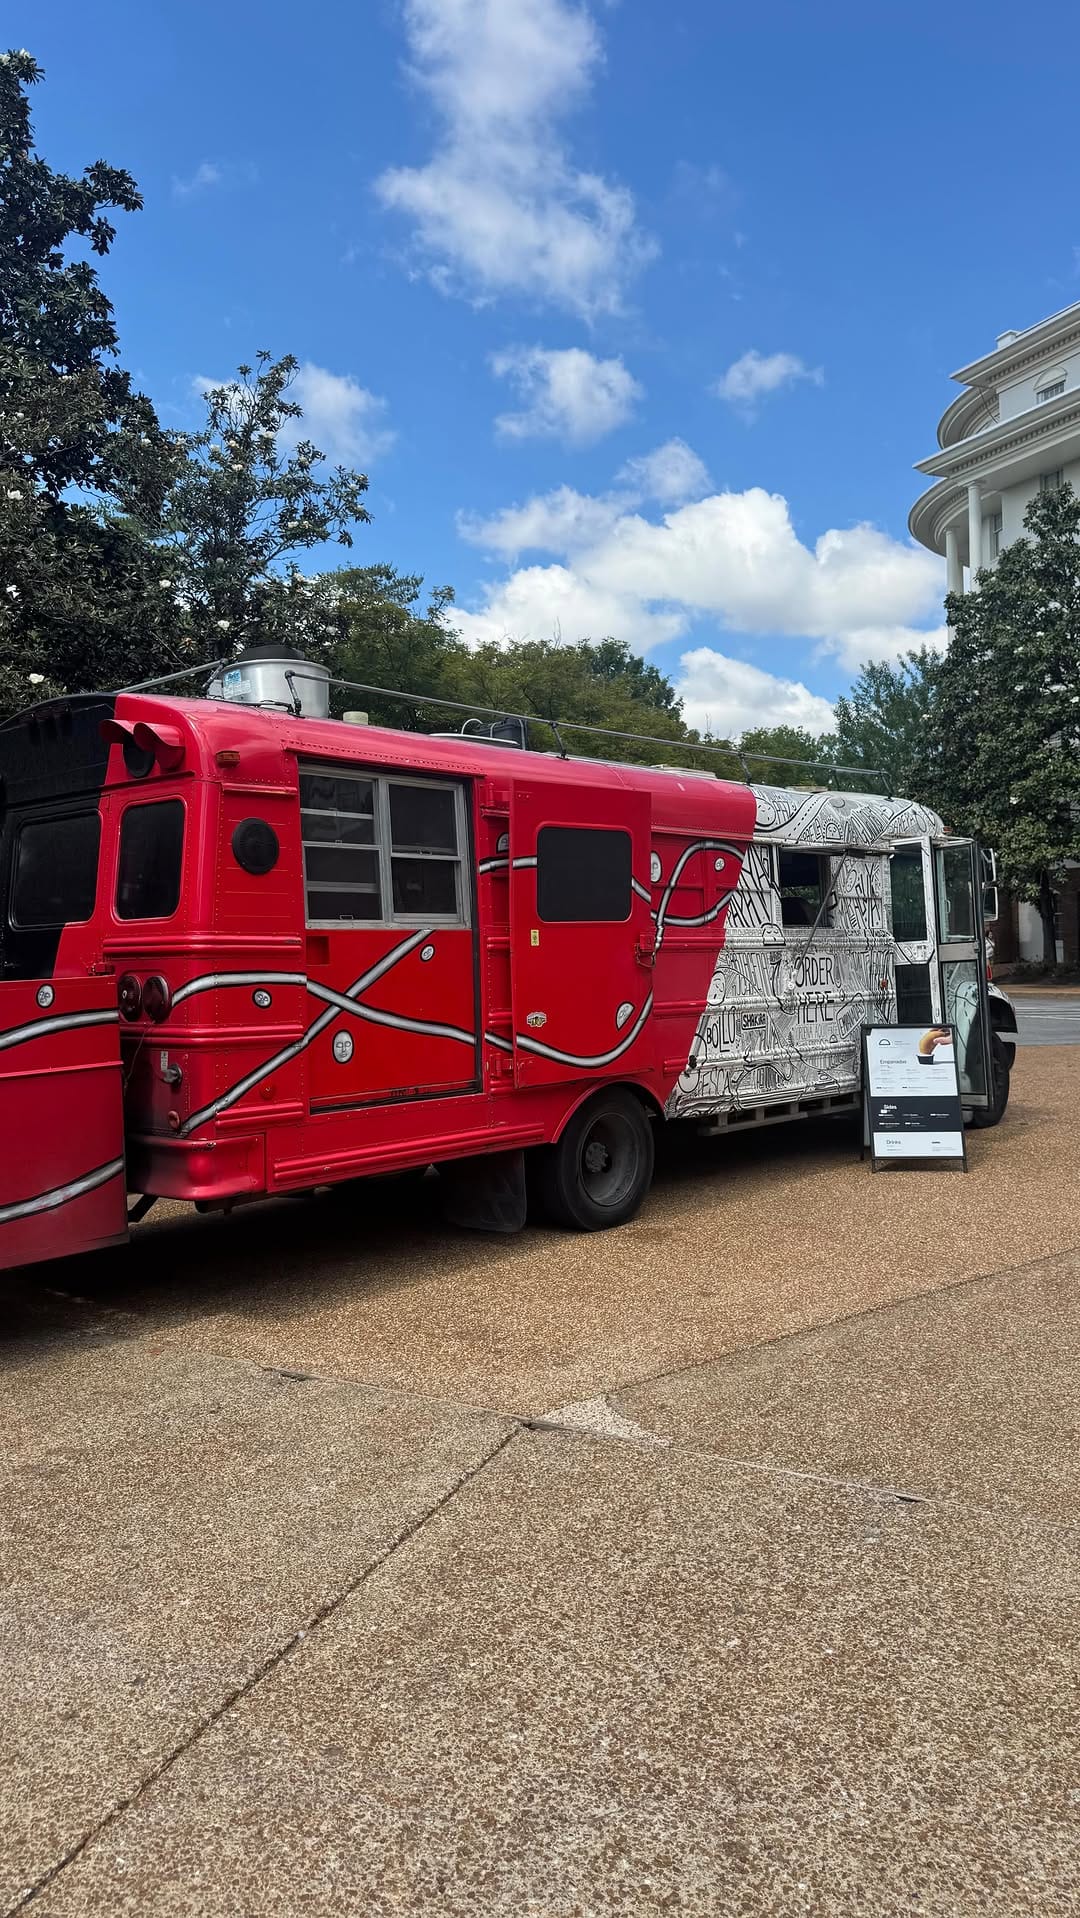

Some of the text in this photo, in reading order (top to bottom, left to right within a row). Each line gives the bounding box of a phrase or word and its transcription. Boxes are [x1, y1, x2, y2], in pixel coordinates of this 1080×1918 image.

[794, 957, 835, 987] ORDER
[742, 1013, 767, 1028] SHAKIRA
[797, 991, 835, 1025] HERE
[706, 1006, 737, 1052] BOLLO
